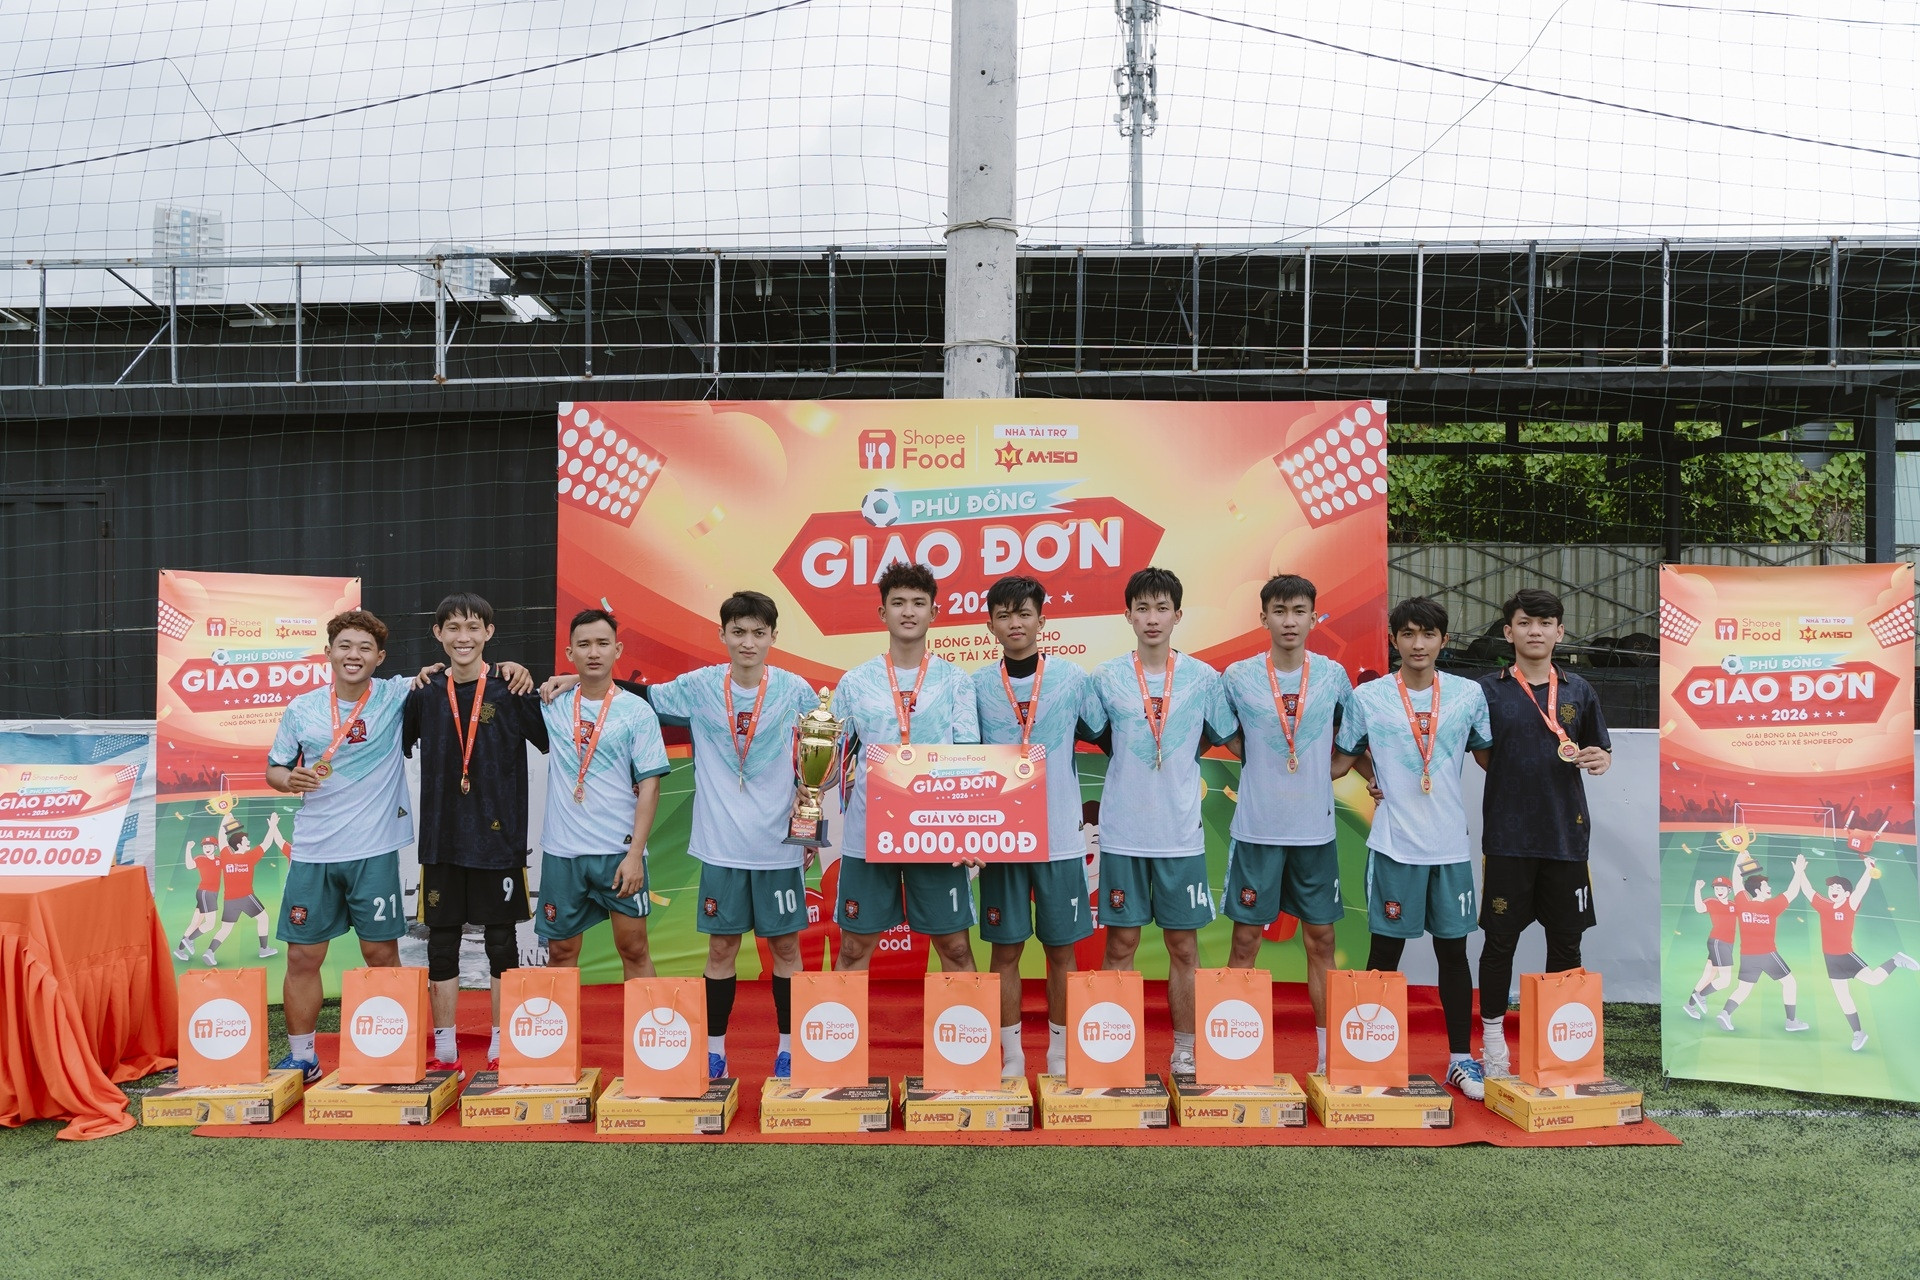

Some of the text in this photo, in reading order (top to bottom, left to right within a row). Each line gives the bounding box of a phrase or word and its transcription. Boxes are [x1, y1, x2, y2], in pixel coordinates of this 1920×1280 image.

[903, 429, 965, 448] Shopee
[1005, 427, 1068, 438] NHÀ TÀI TRỢ
[902, 448, 965, 469] Food
[912, 488, 1037, 518] PHÙ ĐỔNG
[801, 518, 1122, 588] GIAO ĐƠN
[230, 618, 261, 628] Shopee
[1742, 618, 1781, 629] Shopee
[229, 627, 261, 638] Food
[1742, 628, 1781, 641] Food
[934, 636, 970, 649] BÓNG
[974, 633, 990, 646] ĐÁ
[235, 651, 259, 662] PHÙ
[961, 649, 979, 662] TÀI
[983, 646, 999, 660] XẾ
[1750, 654, 1823, 670] PHÙ ĐỔNG
[181, 663, 332, 692] GIAO ĐƠN
[1687, 673, 1874, 705] GIAO ĐƠN
[252, 693, 282, 704] 2026
[1771, 708, 1808, 721] 2026
[940, 754, 986, 764] ShopeeFood
[913, 775, 997, 794] GIAO ĐƠN
[0, 793, 82, 810] GIAO ĐƠN
[918, 812, 997, 825] GIẢI VÔ ĐỊCH
[17, 828, 41, 839] PHÁ
[44, 828, 73, 839] LƯỚI
[877, 831, 1037, 854] 8.000.000Đ
[502, 877, 514, 902] 9
[1187, 882, 1208, 909] 14
[774, 889, 797, 915] 10
[949, 888, 958, 913] 1
[373, 894, 397, 922] 21
[1752, 917, 1770, 925] Food
[216, 1018, 247, 1027] Shopee
[376, 1015, 404, 1026] Shopee
[535, 1017, 564, 1027] Shopee
[826, 1021, 854, 1031] Shopee
[1230, 1019, 1259, 1029] Shopee
[1569, 1020, 1593, 1030] Shopee
[215, 1025, 247, 1038] Food
[375, 1024, 404, 1036] Food
[534, 1025, 564, 1037] Food
[659, 1028, 687, 1037] Shopee
[959, 1024, 987, 1034] Shopee
[1102, 1022, 1131, 1032] Shopee
[1230, 1027, 1259, 1039] Food
[1367, 1022, 1395, 1032] Shopee
[826, 1029, 854, 1041] Food
[958, 1032, 987, 1044] Food
[1102, 1029, 1131, 1041] Food
[1366, 1030, 1395, 1042] Food
[1569, 1028, 1593, 1040] Food
[658, 1036, 687, 1048] Food
